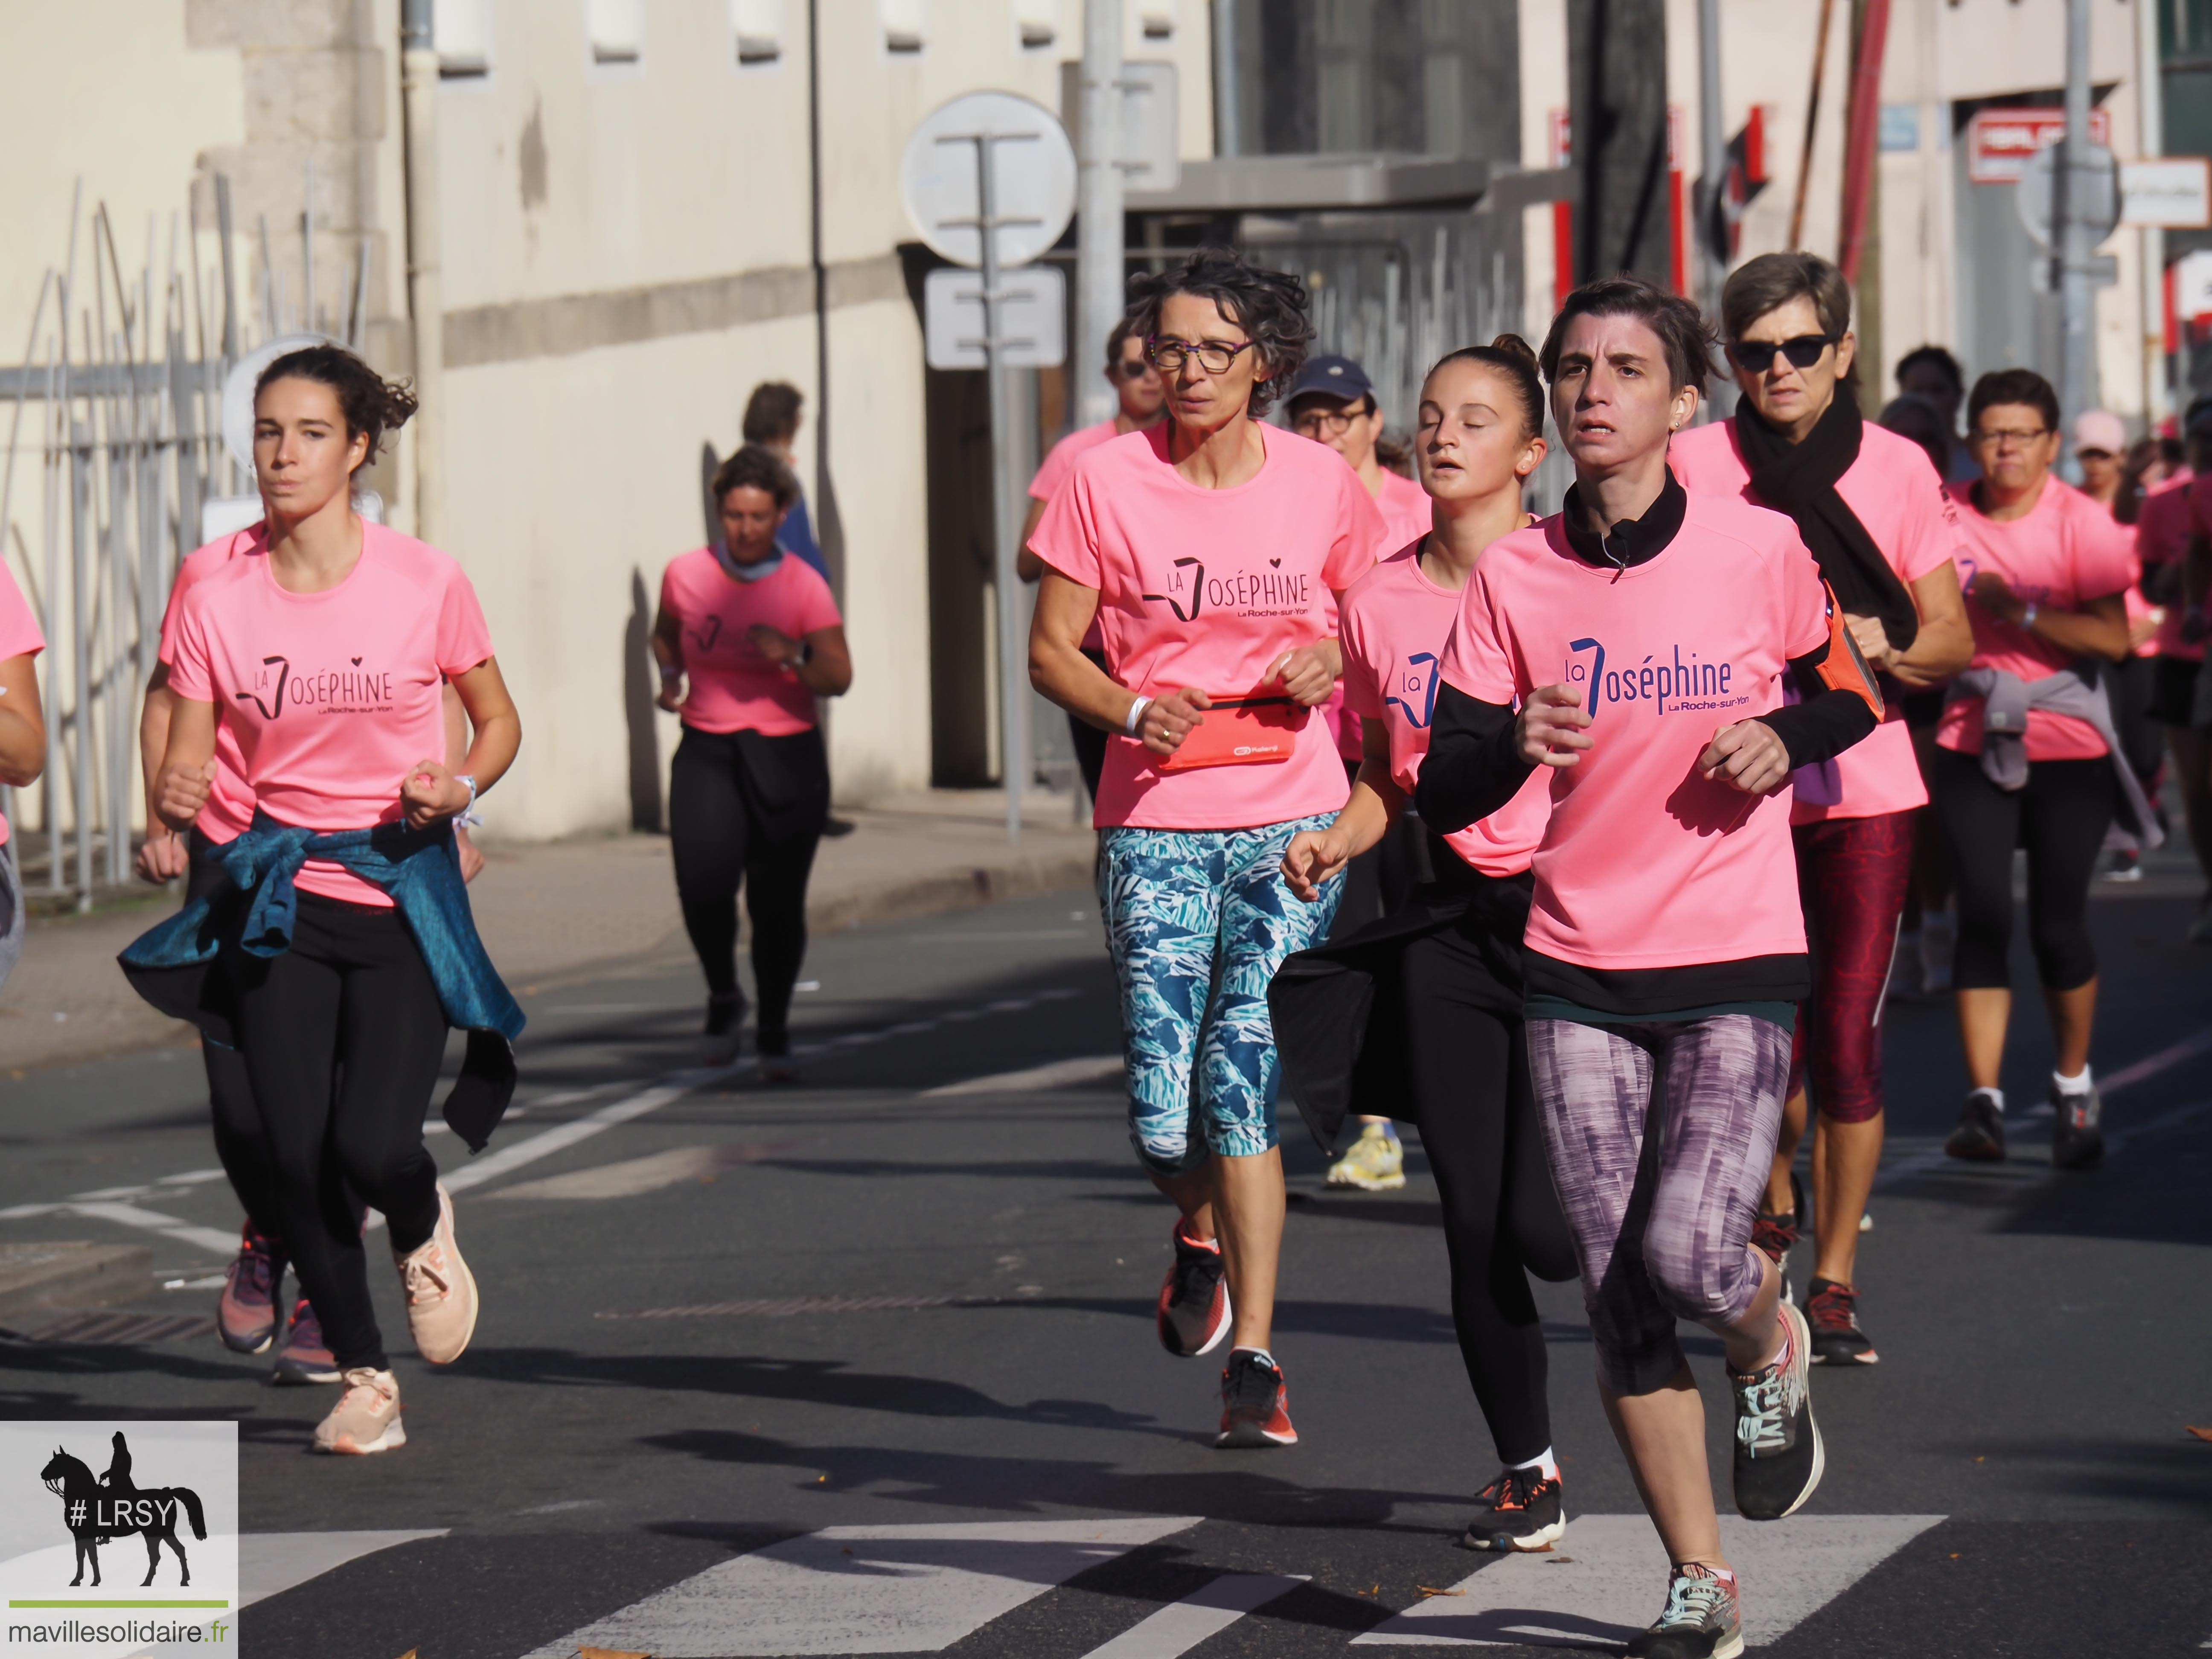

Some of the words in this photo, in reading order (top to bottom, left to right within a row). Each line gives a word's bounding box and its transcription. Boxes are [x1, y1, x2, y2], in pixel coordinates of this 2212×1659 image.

[1167, 572, 1184, 592] LA
[1248, 608, 1308, 617] Roche-sur-Yon
[255, 670, 268, 690] LA
[1565, 659, 1585, 682] la
[1402, 672, 1420, 693] la
[1680, 696, 1749, 711] Roche-sur-Yon
